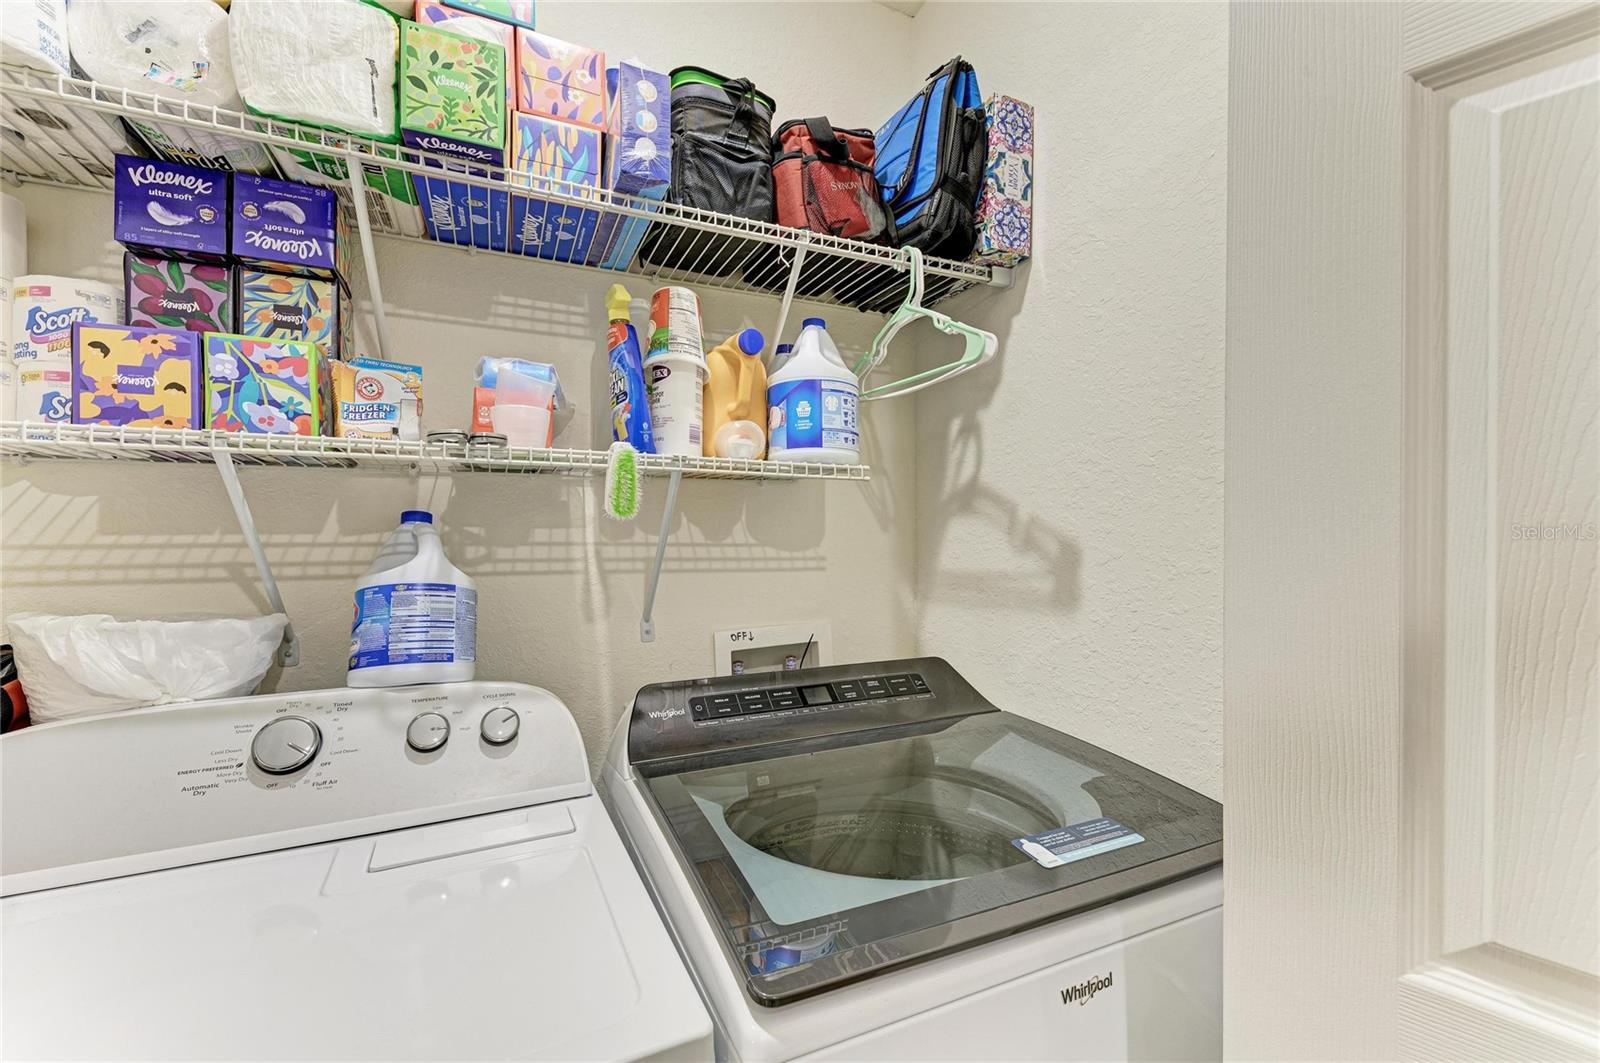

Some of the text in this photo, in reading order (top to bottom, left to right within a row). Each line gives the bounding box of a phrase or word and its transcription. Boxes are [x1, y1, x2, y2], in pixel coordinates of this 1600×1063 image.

[433, 74, 472, 92] Kleenex
[415, 137, 492, 160] Kleenex
[128, 164, 213, 194] Kleenex
[148, 188, 193, 201] ultra soft
[315, 189, 327, 198] 85
[263, 223, 305, 236] ultra soft
[124, 232, 138, 241] 85
[245, 230, 323, 259] Kleenex
[158, 299, 200, 313] Kleenex
[33, 308, 86, 333] Scott
[273, 311, 307, 325] Kleenex
[112, 373, 159, 388] Kleenex
[343, 403, 394, 413] FRIDGE-N-
[343, 412, 386, 421] FREEZER
[730, 631, 748, 642] OFF
[411, 695, 449, 703] TEMPERATURE
[648, 707, 686, 721] Whirlpool
[177, 764, 234, 776] ENERGY PREFERRED
[181, 782, 220, 792] Automatic
[192, 789, 207, 797] Dry
[1061, 972, 1113, 1005] Whirlpool
